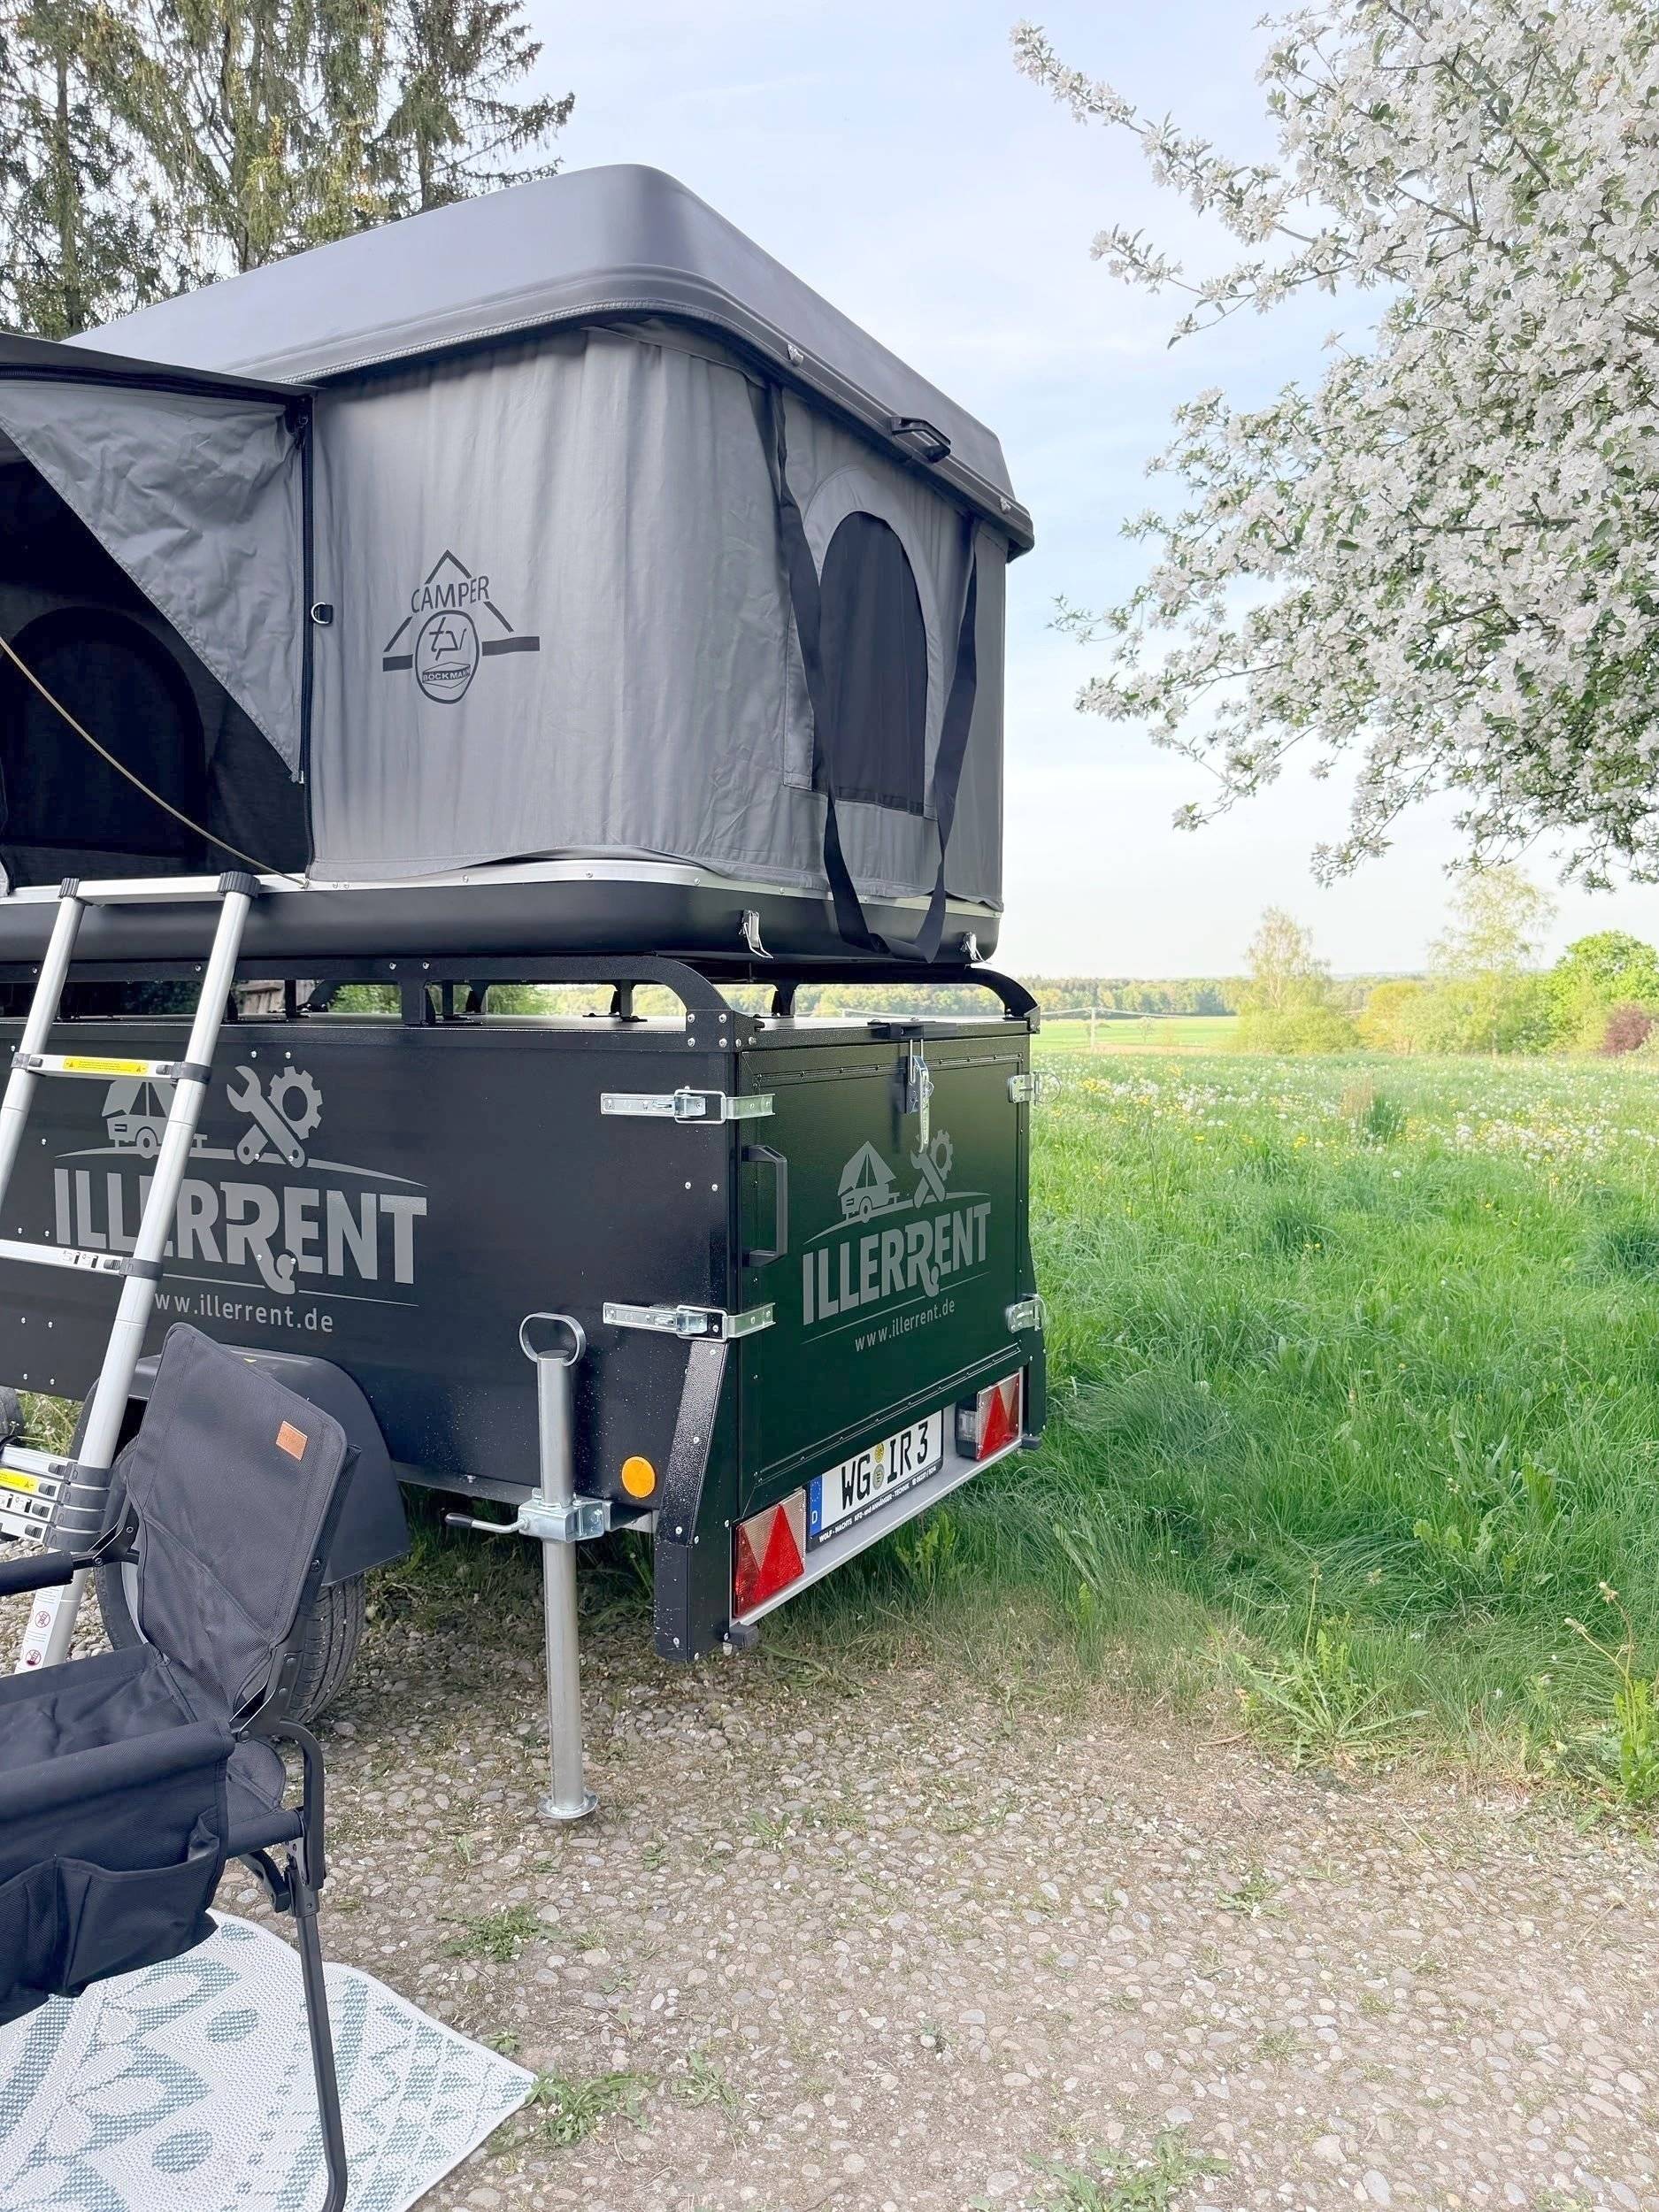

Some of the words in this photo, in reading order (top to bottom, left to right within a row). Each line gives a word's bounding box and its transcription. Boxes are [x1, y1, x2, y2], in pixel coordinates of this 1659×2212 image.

[411, 575, 489, 613] CAMPER
[803, 1202, 991, 1325] ILLERRENT
[154, 1292, 334, 1333] ww.illerrent.de
[855, 1298, 956, 1352] www.illerrent.de
[841, 1453, 871, 1510] WG
[811, 1509, 818, 1525] D
